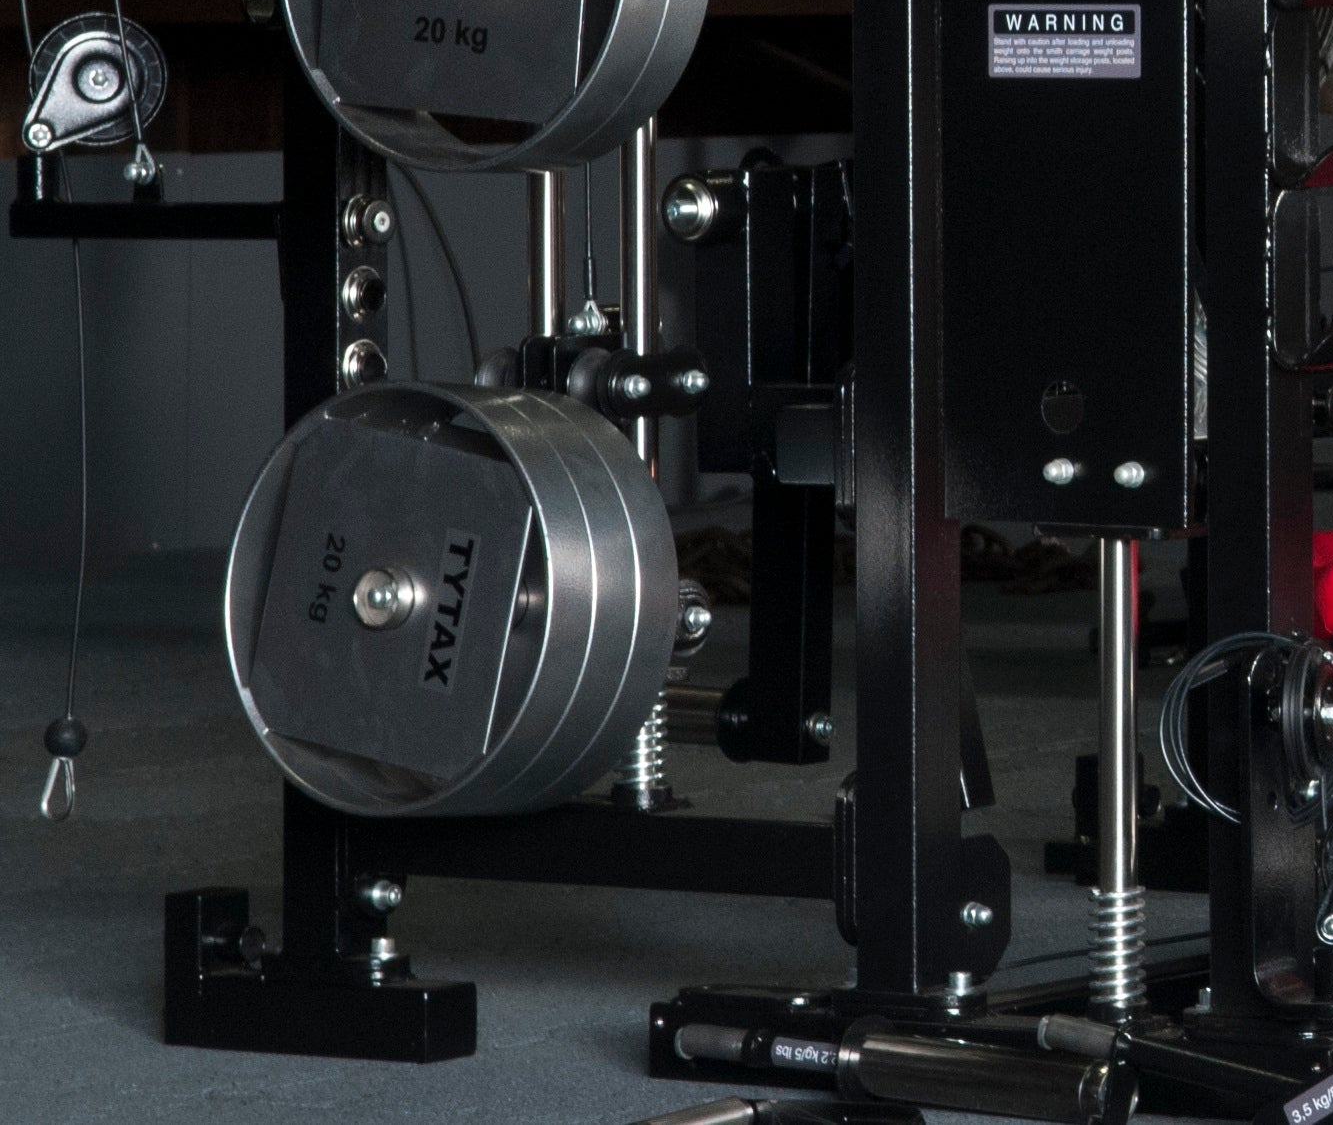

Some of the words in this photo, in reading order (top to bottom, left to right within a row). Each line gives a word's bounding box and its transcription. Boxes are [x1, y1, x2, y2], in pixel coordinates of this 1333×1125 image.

[414, 16, 446, 44] 20
[454, 19, 489, 54] kg
[1006, 13, 1124, 32] WARNING
[322, 533, 346, 572] 20
[308, 583, 337, 623] kg
[423, 539, 475, 686] TYTAX
[775, 1044, 793, 1060] lbs
[794, 1045, 819, 1064] kg/5
[1291, 1102, 1313, 1124] 3,5
